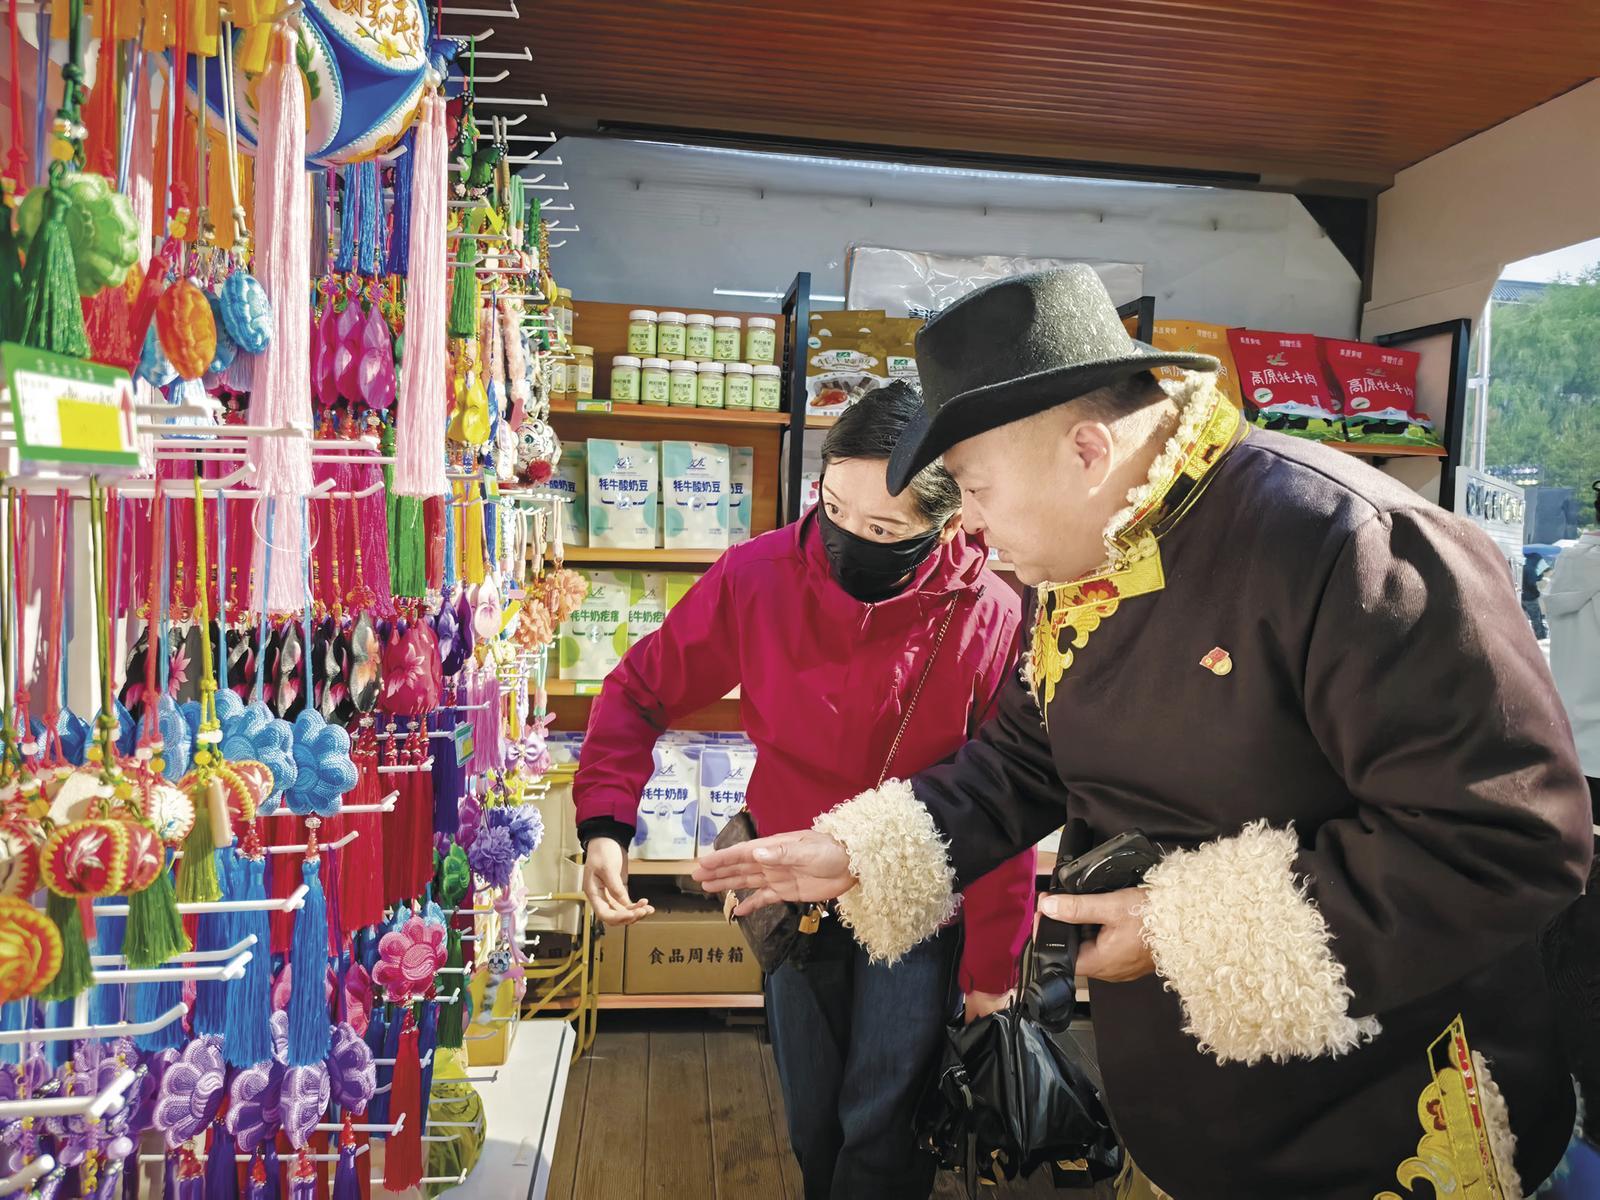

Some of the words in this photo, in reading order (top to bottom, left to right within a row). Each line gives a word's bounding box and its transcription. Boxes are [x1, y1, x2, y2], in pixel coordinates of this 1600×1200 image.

[1249, 368, 1318, 386] 高原牦牛肉
[599, 478, 648, 492] 牦牛酸奶豆
[673, 480, 720, 493] 牦牛酸奶豆
[648, 946, 744, 968] 食品周转箱
